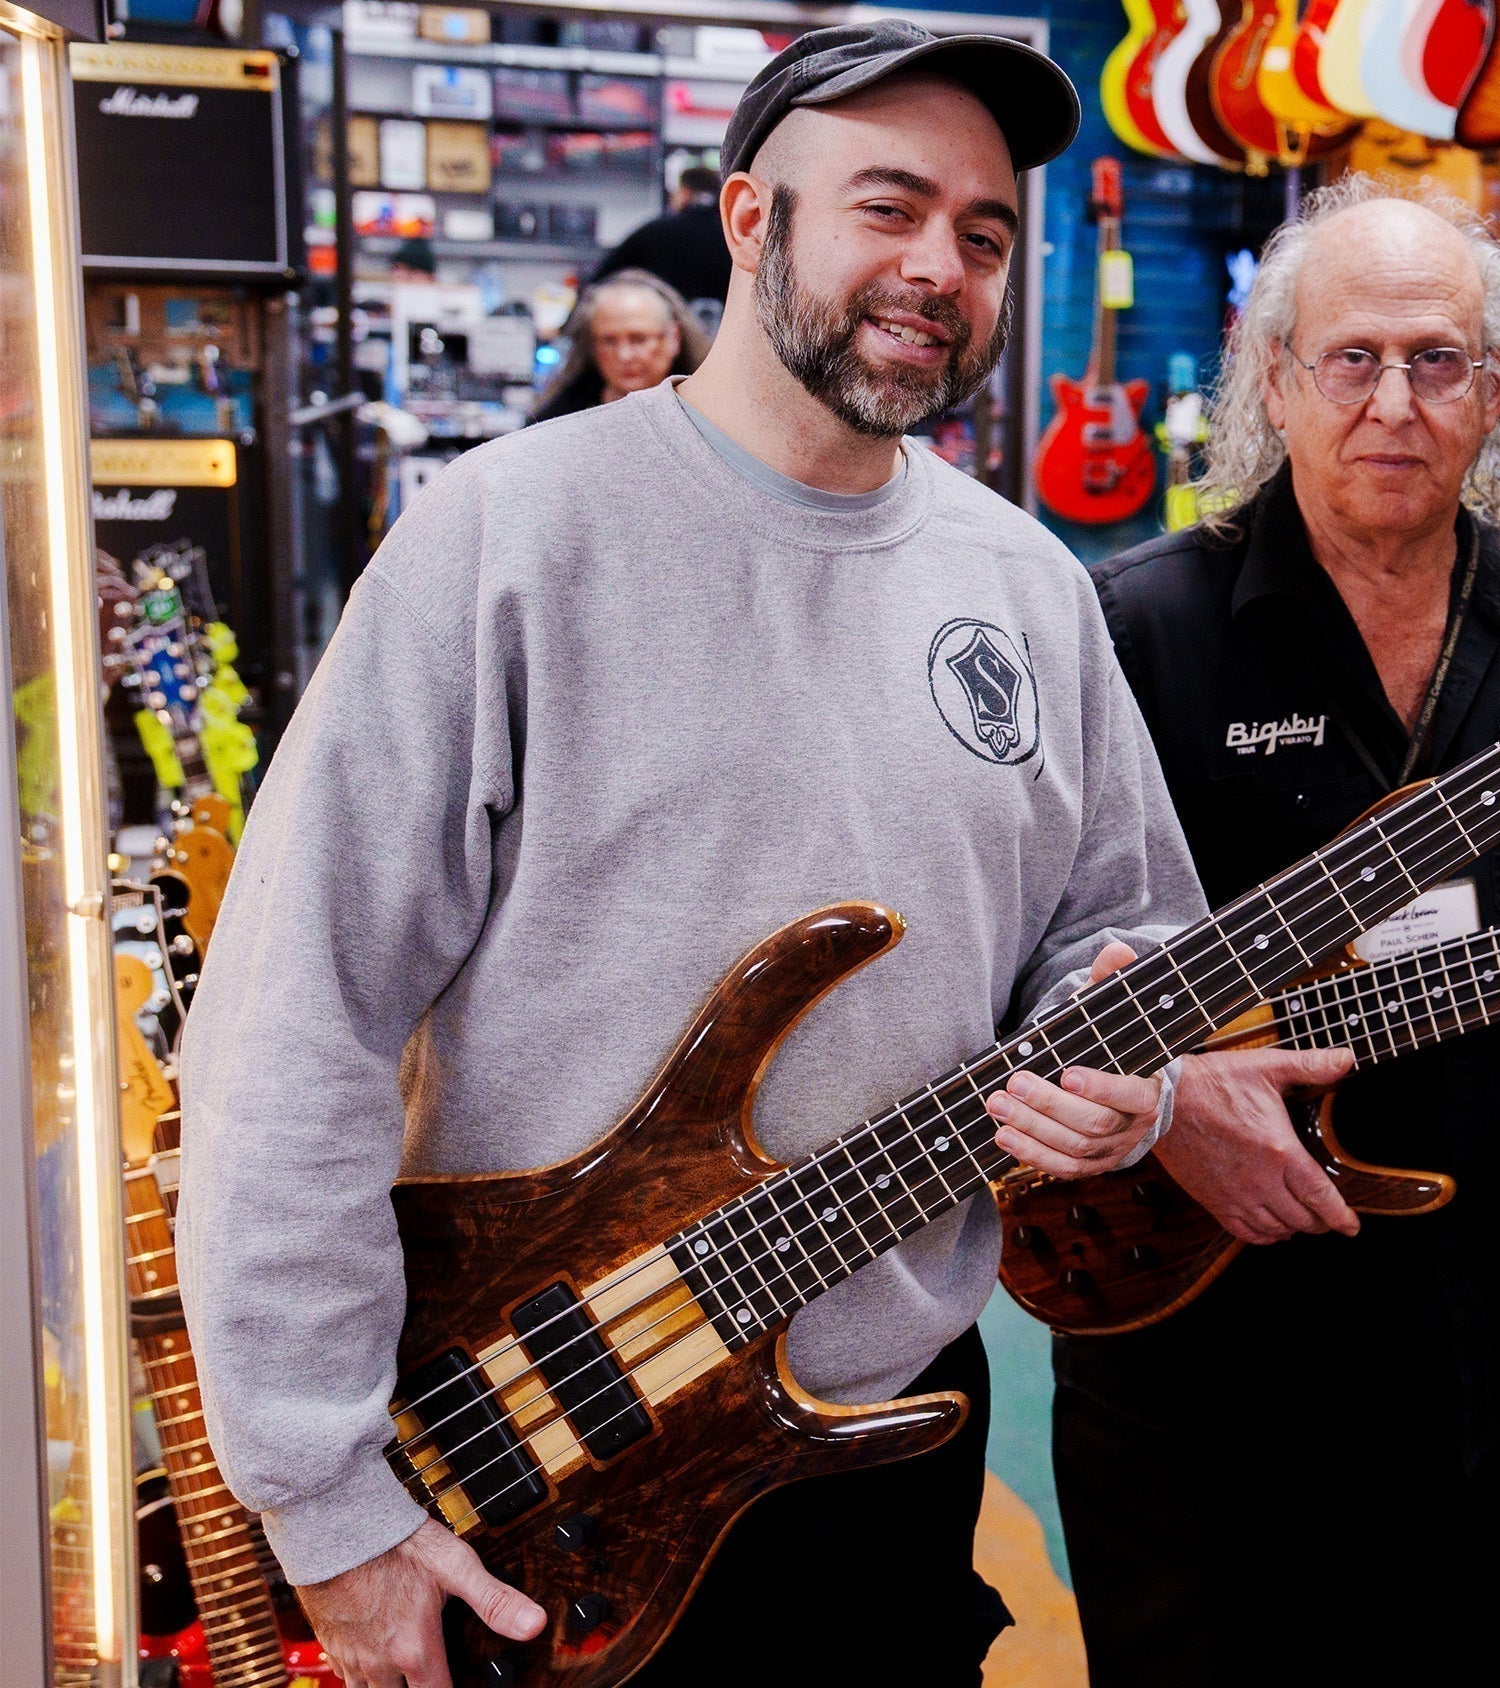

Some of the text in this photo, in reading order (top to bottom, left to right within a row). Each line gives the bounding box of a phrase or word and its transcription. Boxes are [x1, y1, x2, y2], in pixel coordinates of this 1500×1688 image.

[975, 653, 1012, 718] S
[1226, 712, 1326, 756] Bigsby
[1380, 936, 1403, 948] PAUL
[1406, 932, 1439, 943] SCHEIN
